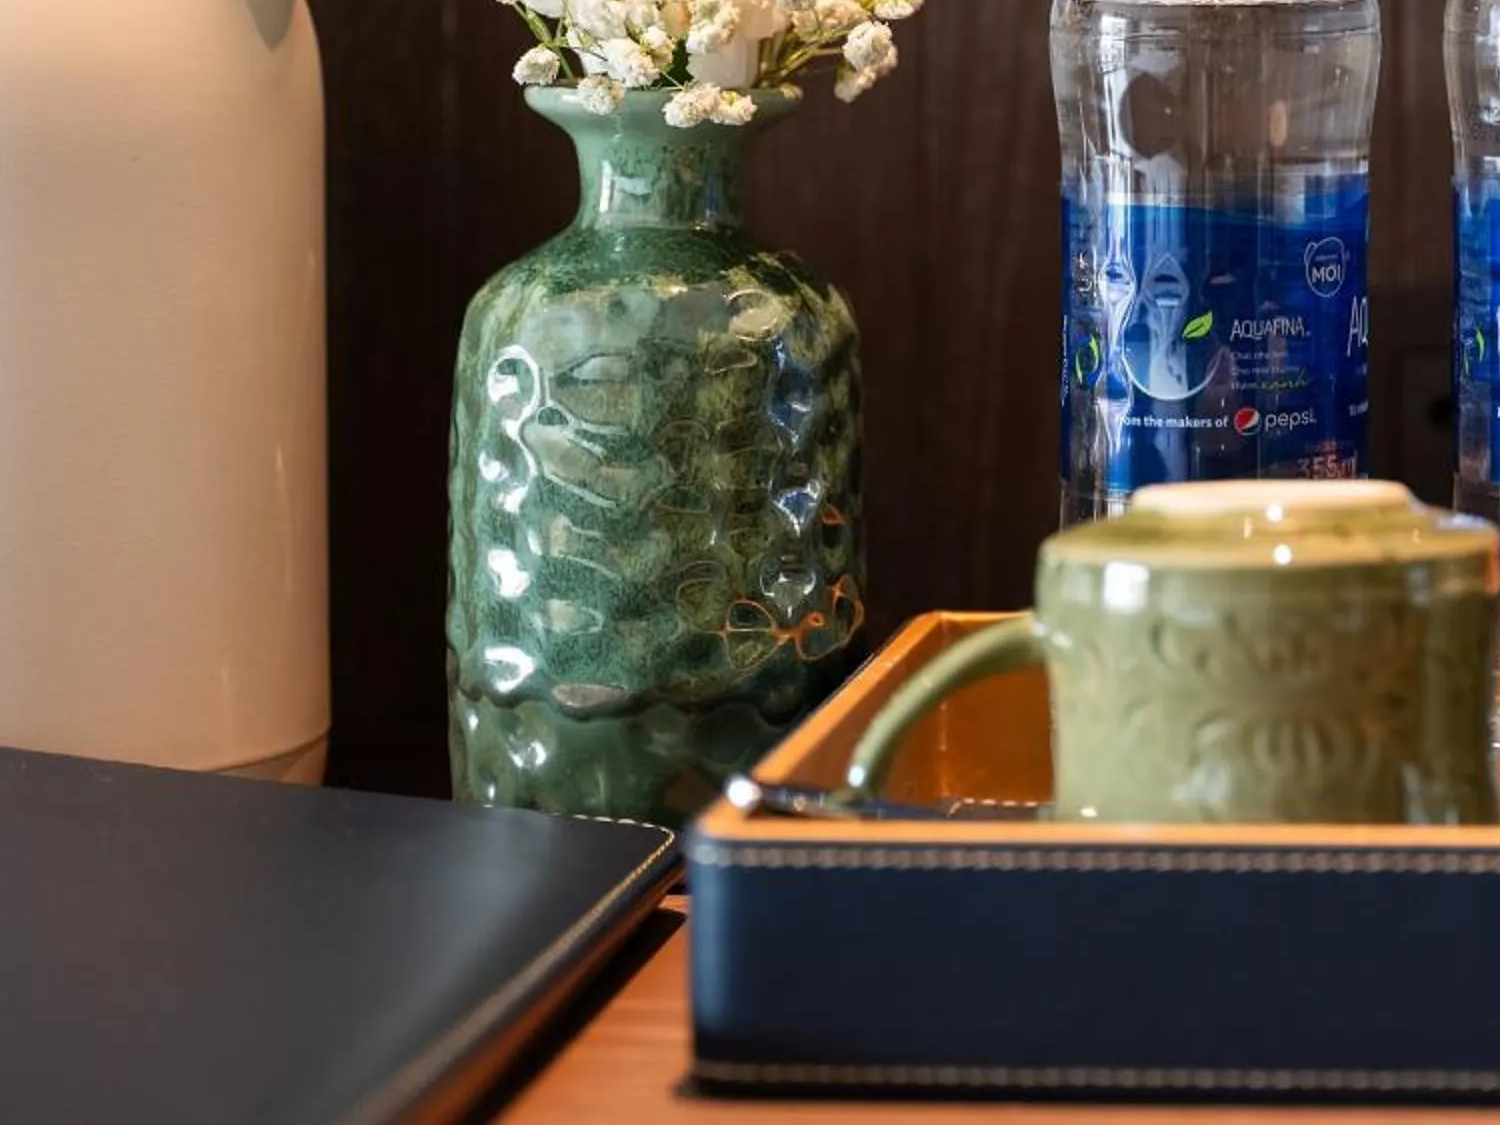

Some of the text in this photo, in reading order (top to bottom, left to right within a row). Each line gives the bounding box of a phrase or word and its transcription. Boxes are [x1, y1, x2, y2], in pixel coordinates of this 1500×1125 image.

[1229, 315, 1305, 342] AQUAFINA
[1143, 415, 1163, 428] the
[1165, 416, 1212, 428] makers
[1215, 416, 1229, 428] of
[1264, 407, 1316, 432] pepsi
